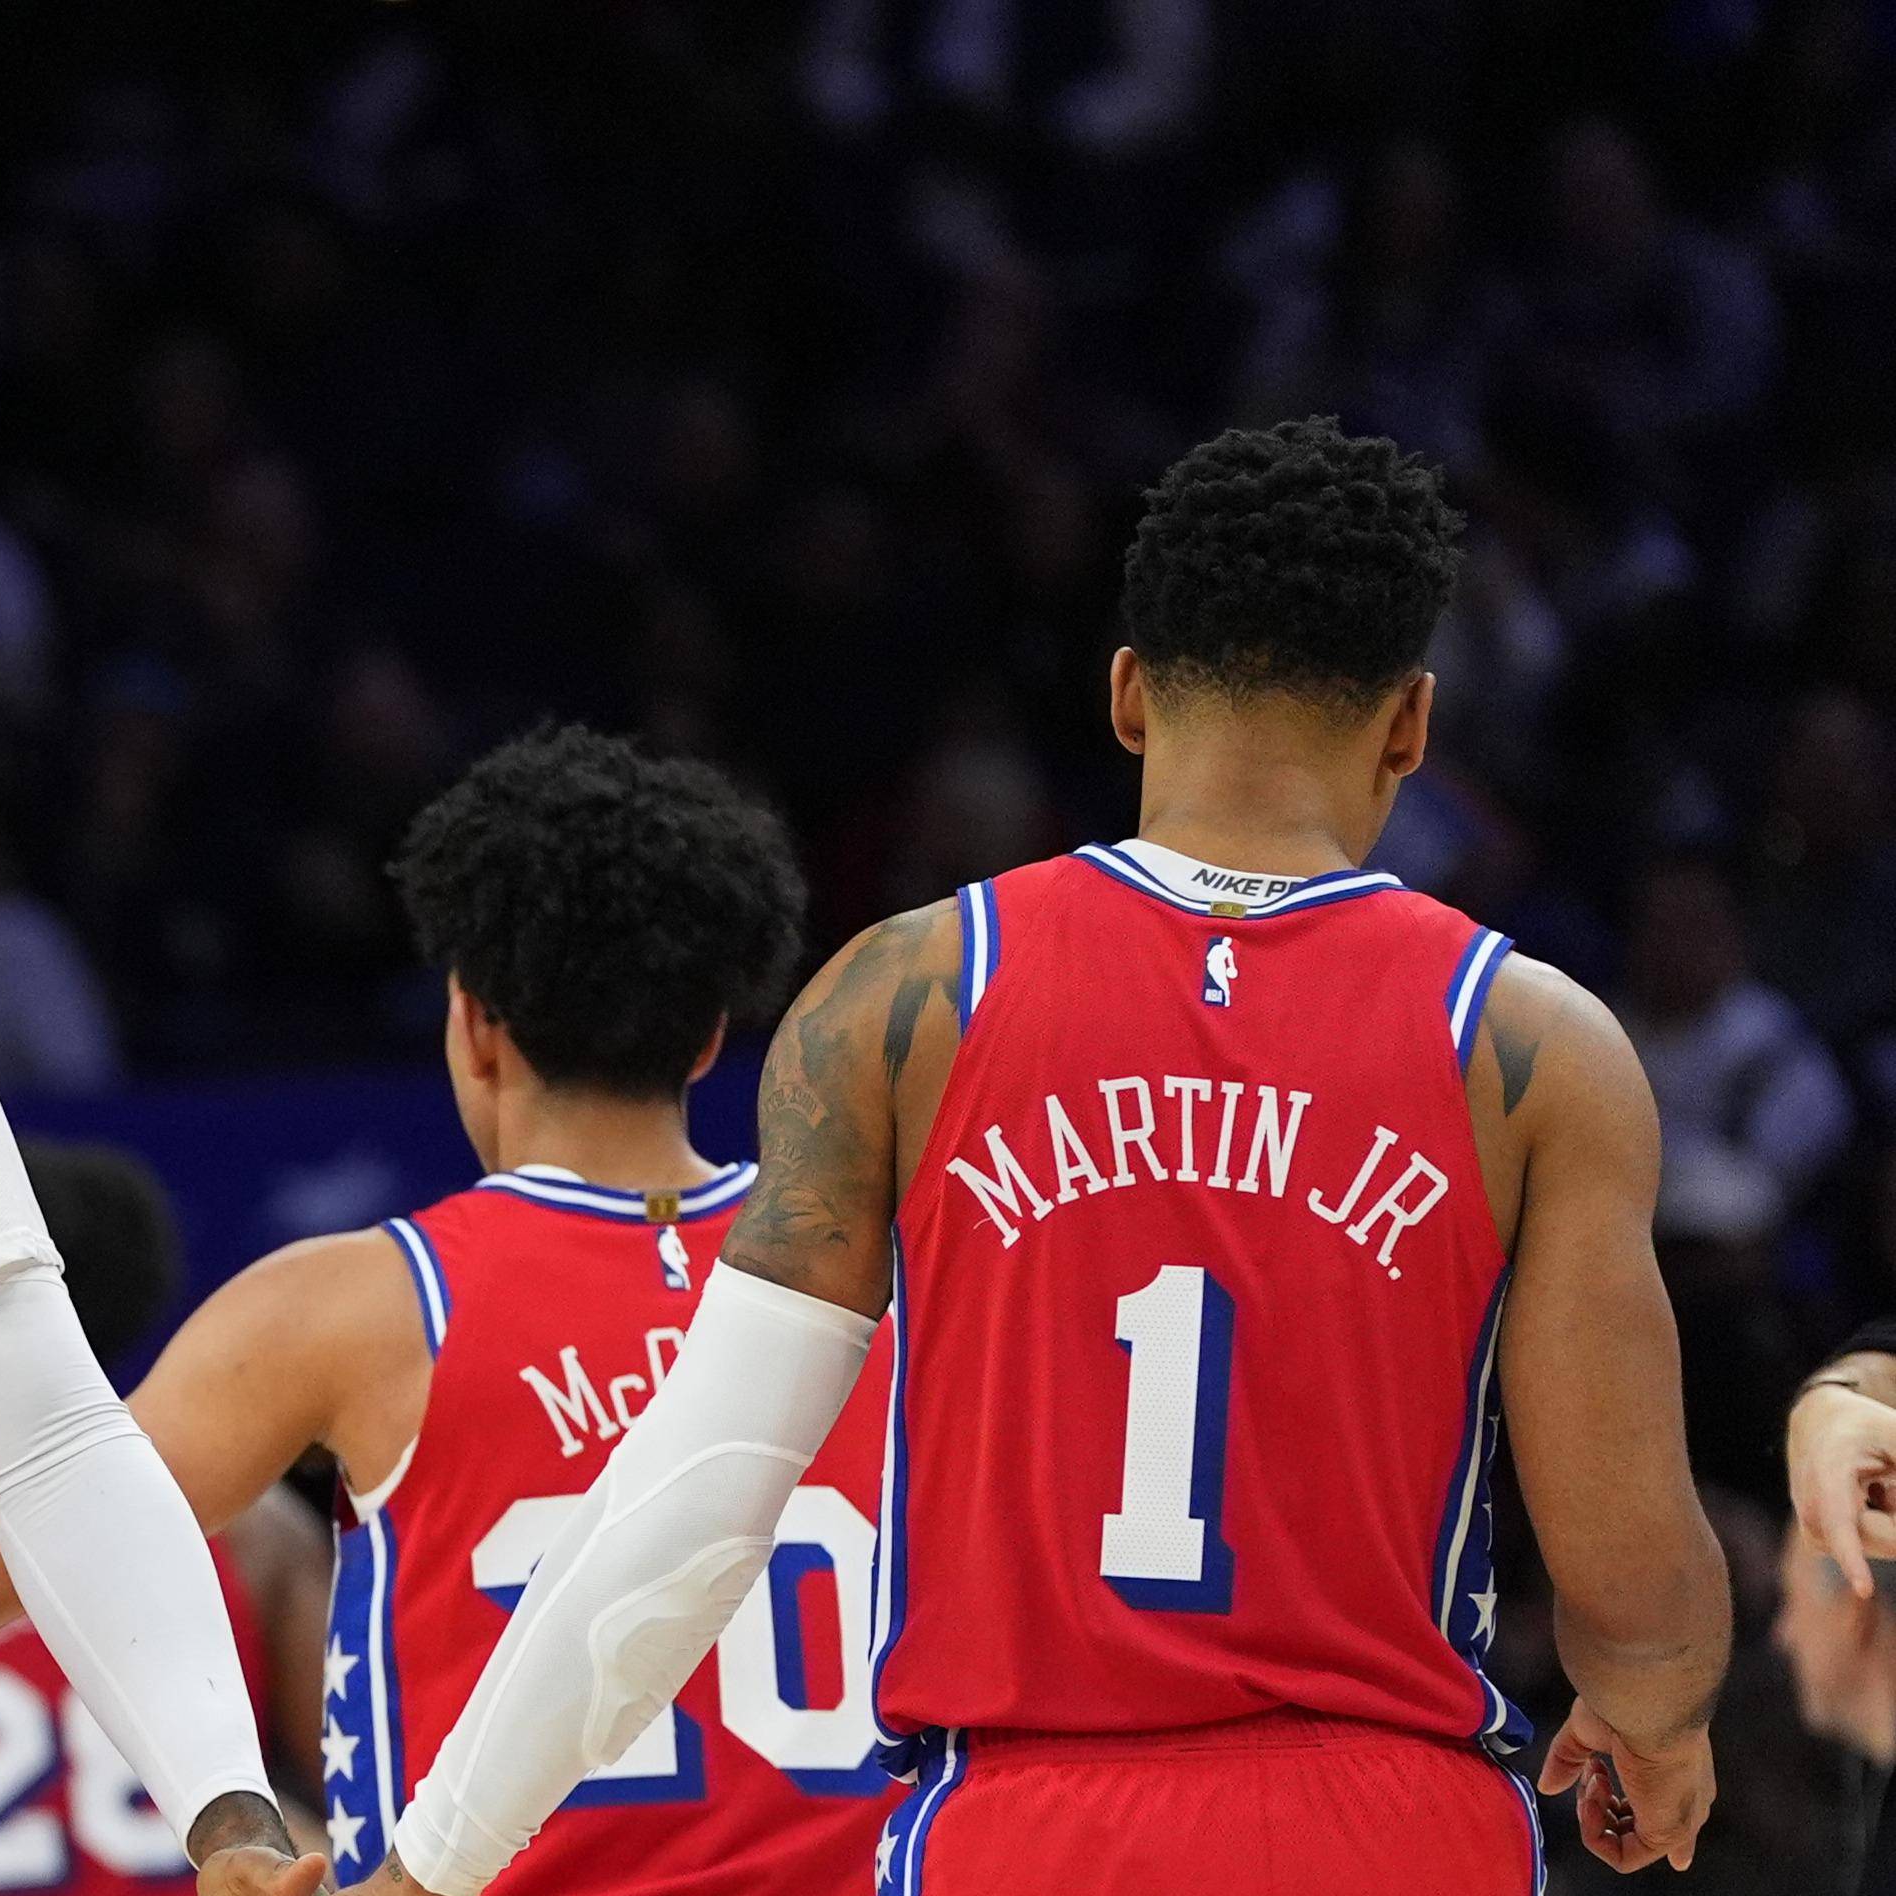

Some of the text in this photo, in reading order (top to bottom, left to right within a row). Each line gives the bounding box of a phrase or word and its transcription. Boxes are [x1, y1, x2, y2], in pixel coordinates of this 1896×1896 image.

[1191, 868, 1264, 897] NIKE
[945, 1073, 1450, 1281] MARTIN JR.
[1099, 1263, 1214, 1590] 1
